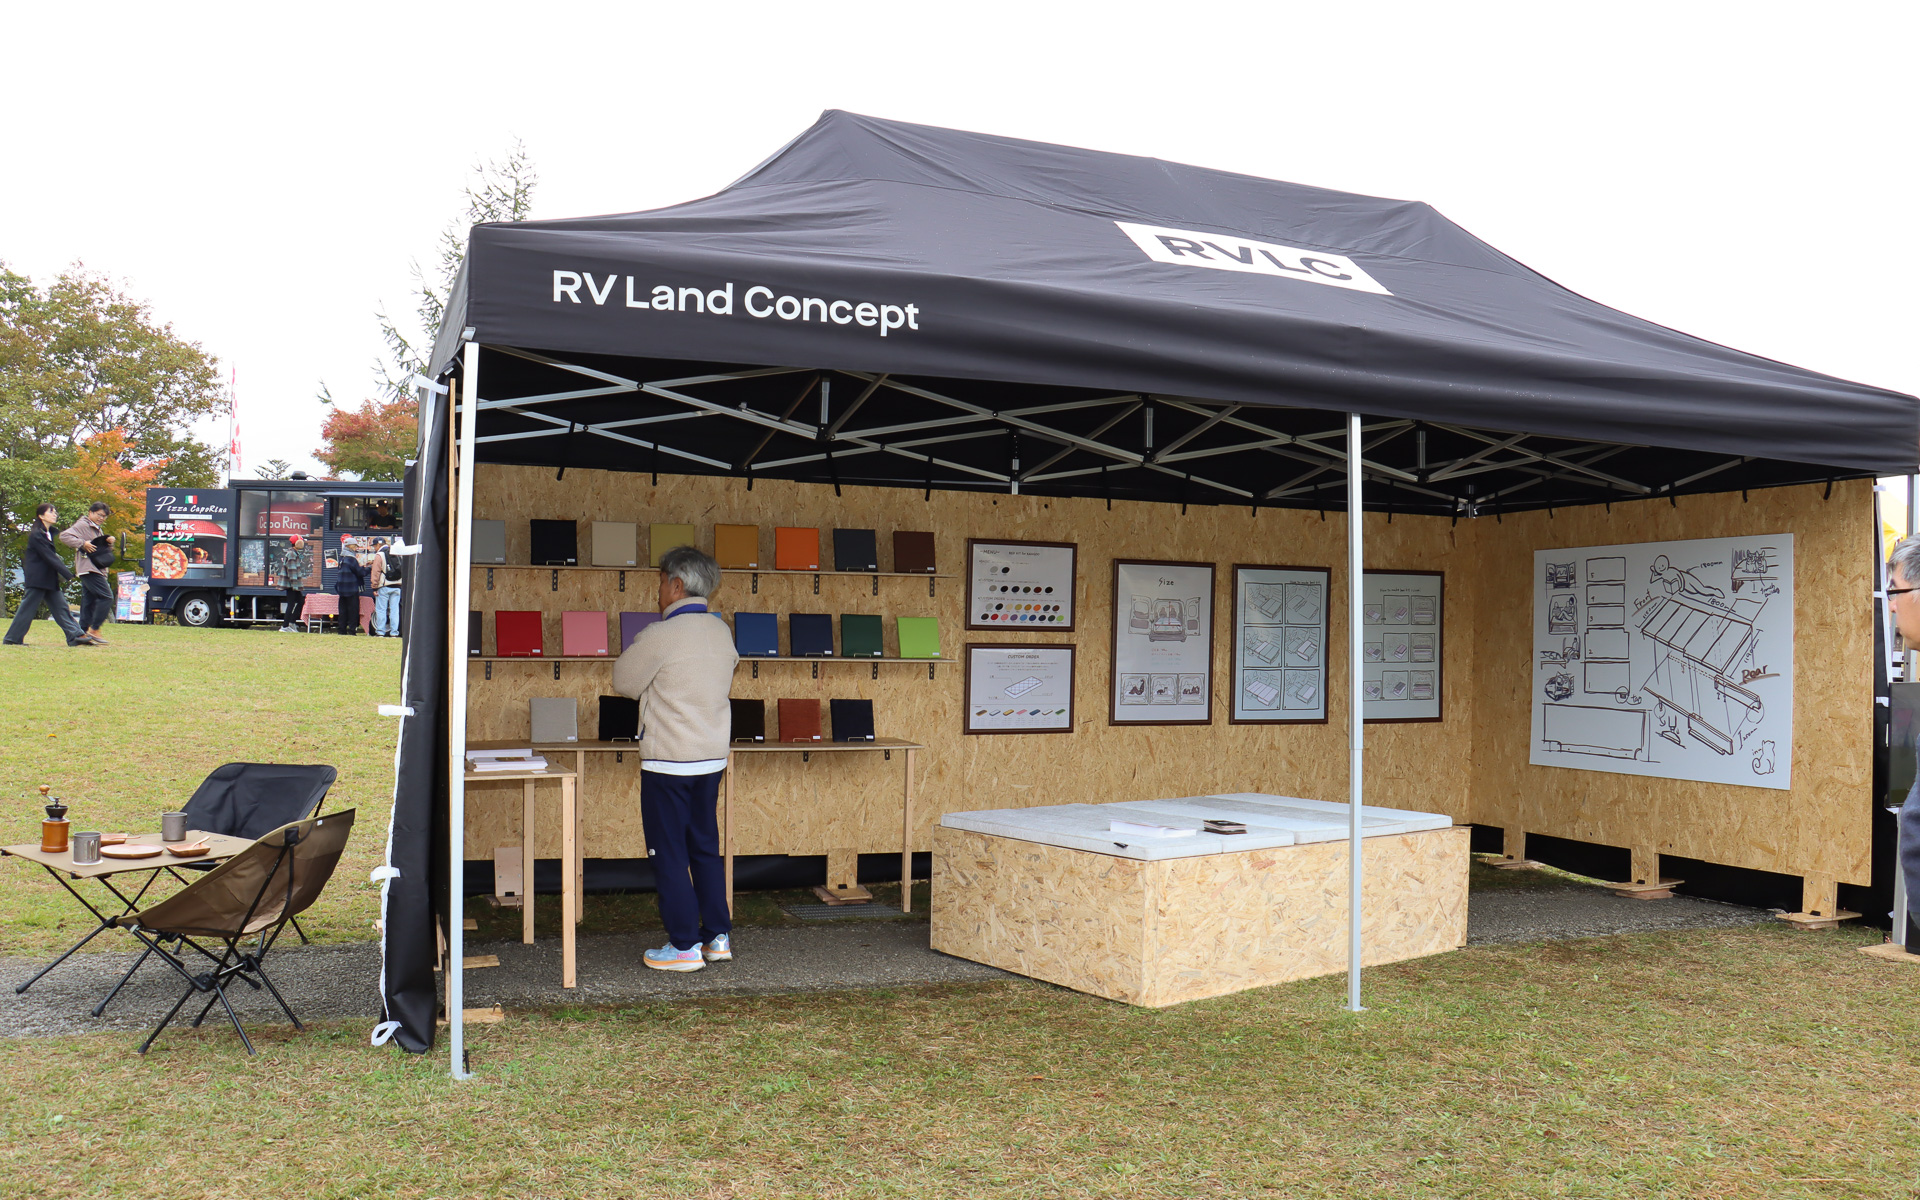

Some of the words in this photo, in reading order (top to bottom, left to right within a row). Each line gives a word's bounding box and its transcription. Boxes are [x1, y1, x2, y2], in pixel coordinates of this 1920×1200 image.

[1153, 234, 1353, 281] RVLC
[553, 269, 618, 305] RV
[625, 275, 734, 315] Land
[744, 285, 919, 337] Concept
[154, 495, 188, 512] Pizza
[158, 531, 194, 541] ピッツァ
[1158, 577, 1174, 587] Size
[1633, 589, 1652, 611] Front
[1742, 664, 1768, 683] Rear
[676, 952, 696, 960] HOKA
